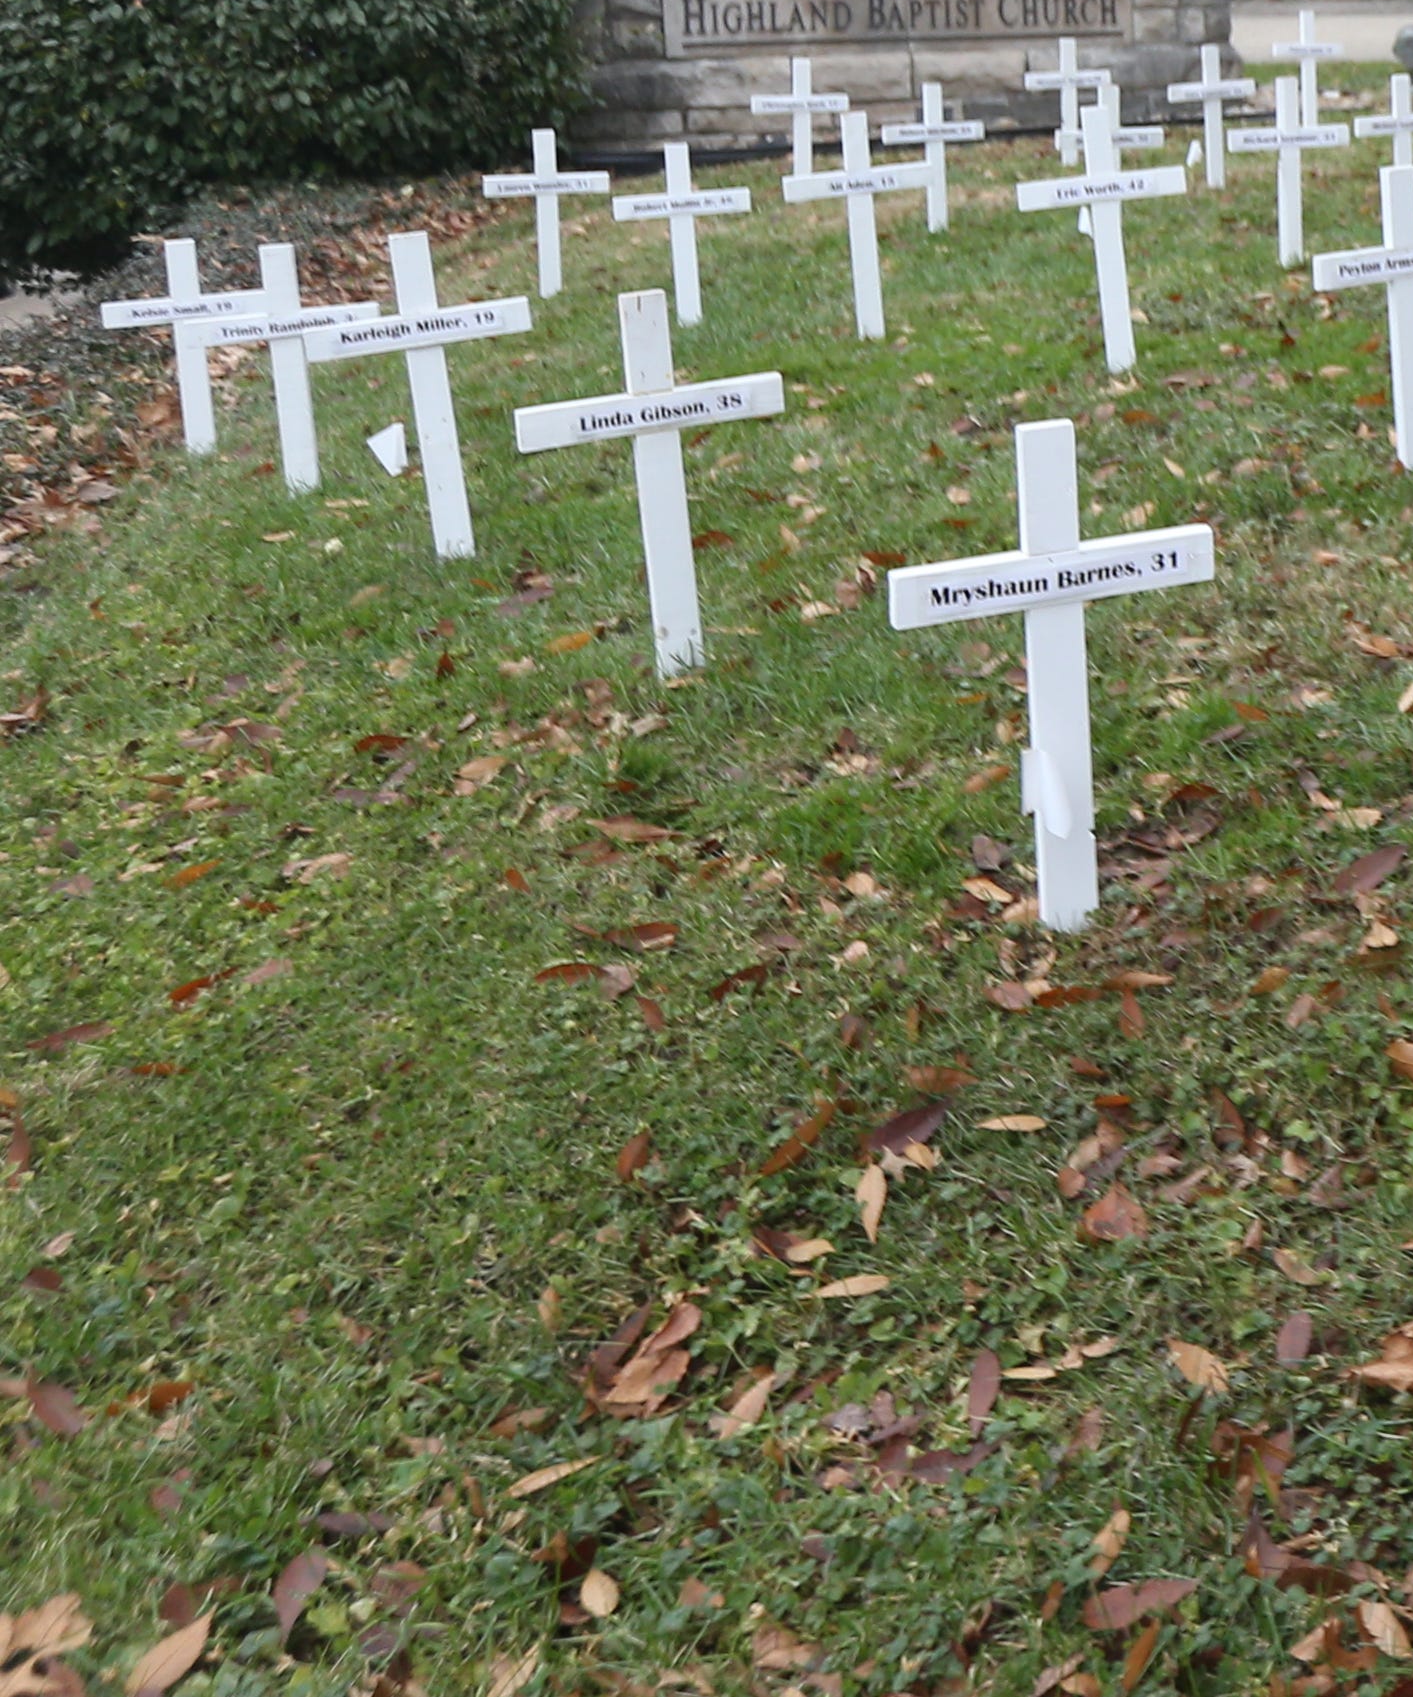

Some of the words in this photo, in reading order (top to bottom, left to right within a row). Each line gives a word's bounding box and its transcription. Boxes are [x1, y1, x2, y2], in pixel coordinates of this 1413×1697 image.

[340, 323, 411, 344] Karleigh
[416, 316, 468, 334] Miller,
[473, 311, 494, 325] 19
[579, 413, 633, 432] Linda
[640, 402, 710, 423] Gibson,
[929, 571, 1049, 608] Mryshaun
[1057, 558, 1142, 589] Barnes,
[1150, 550, 1180, 572] 31
